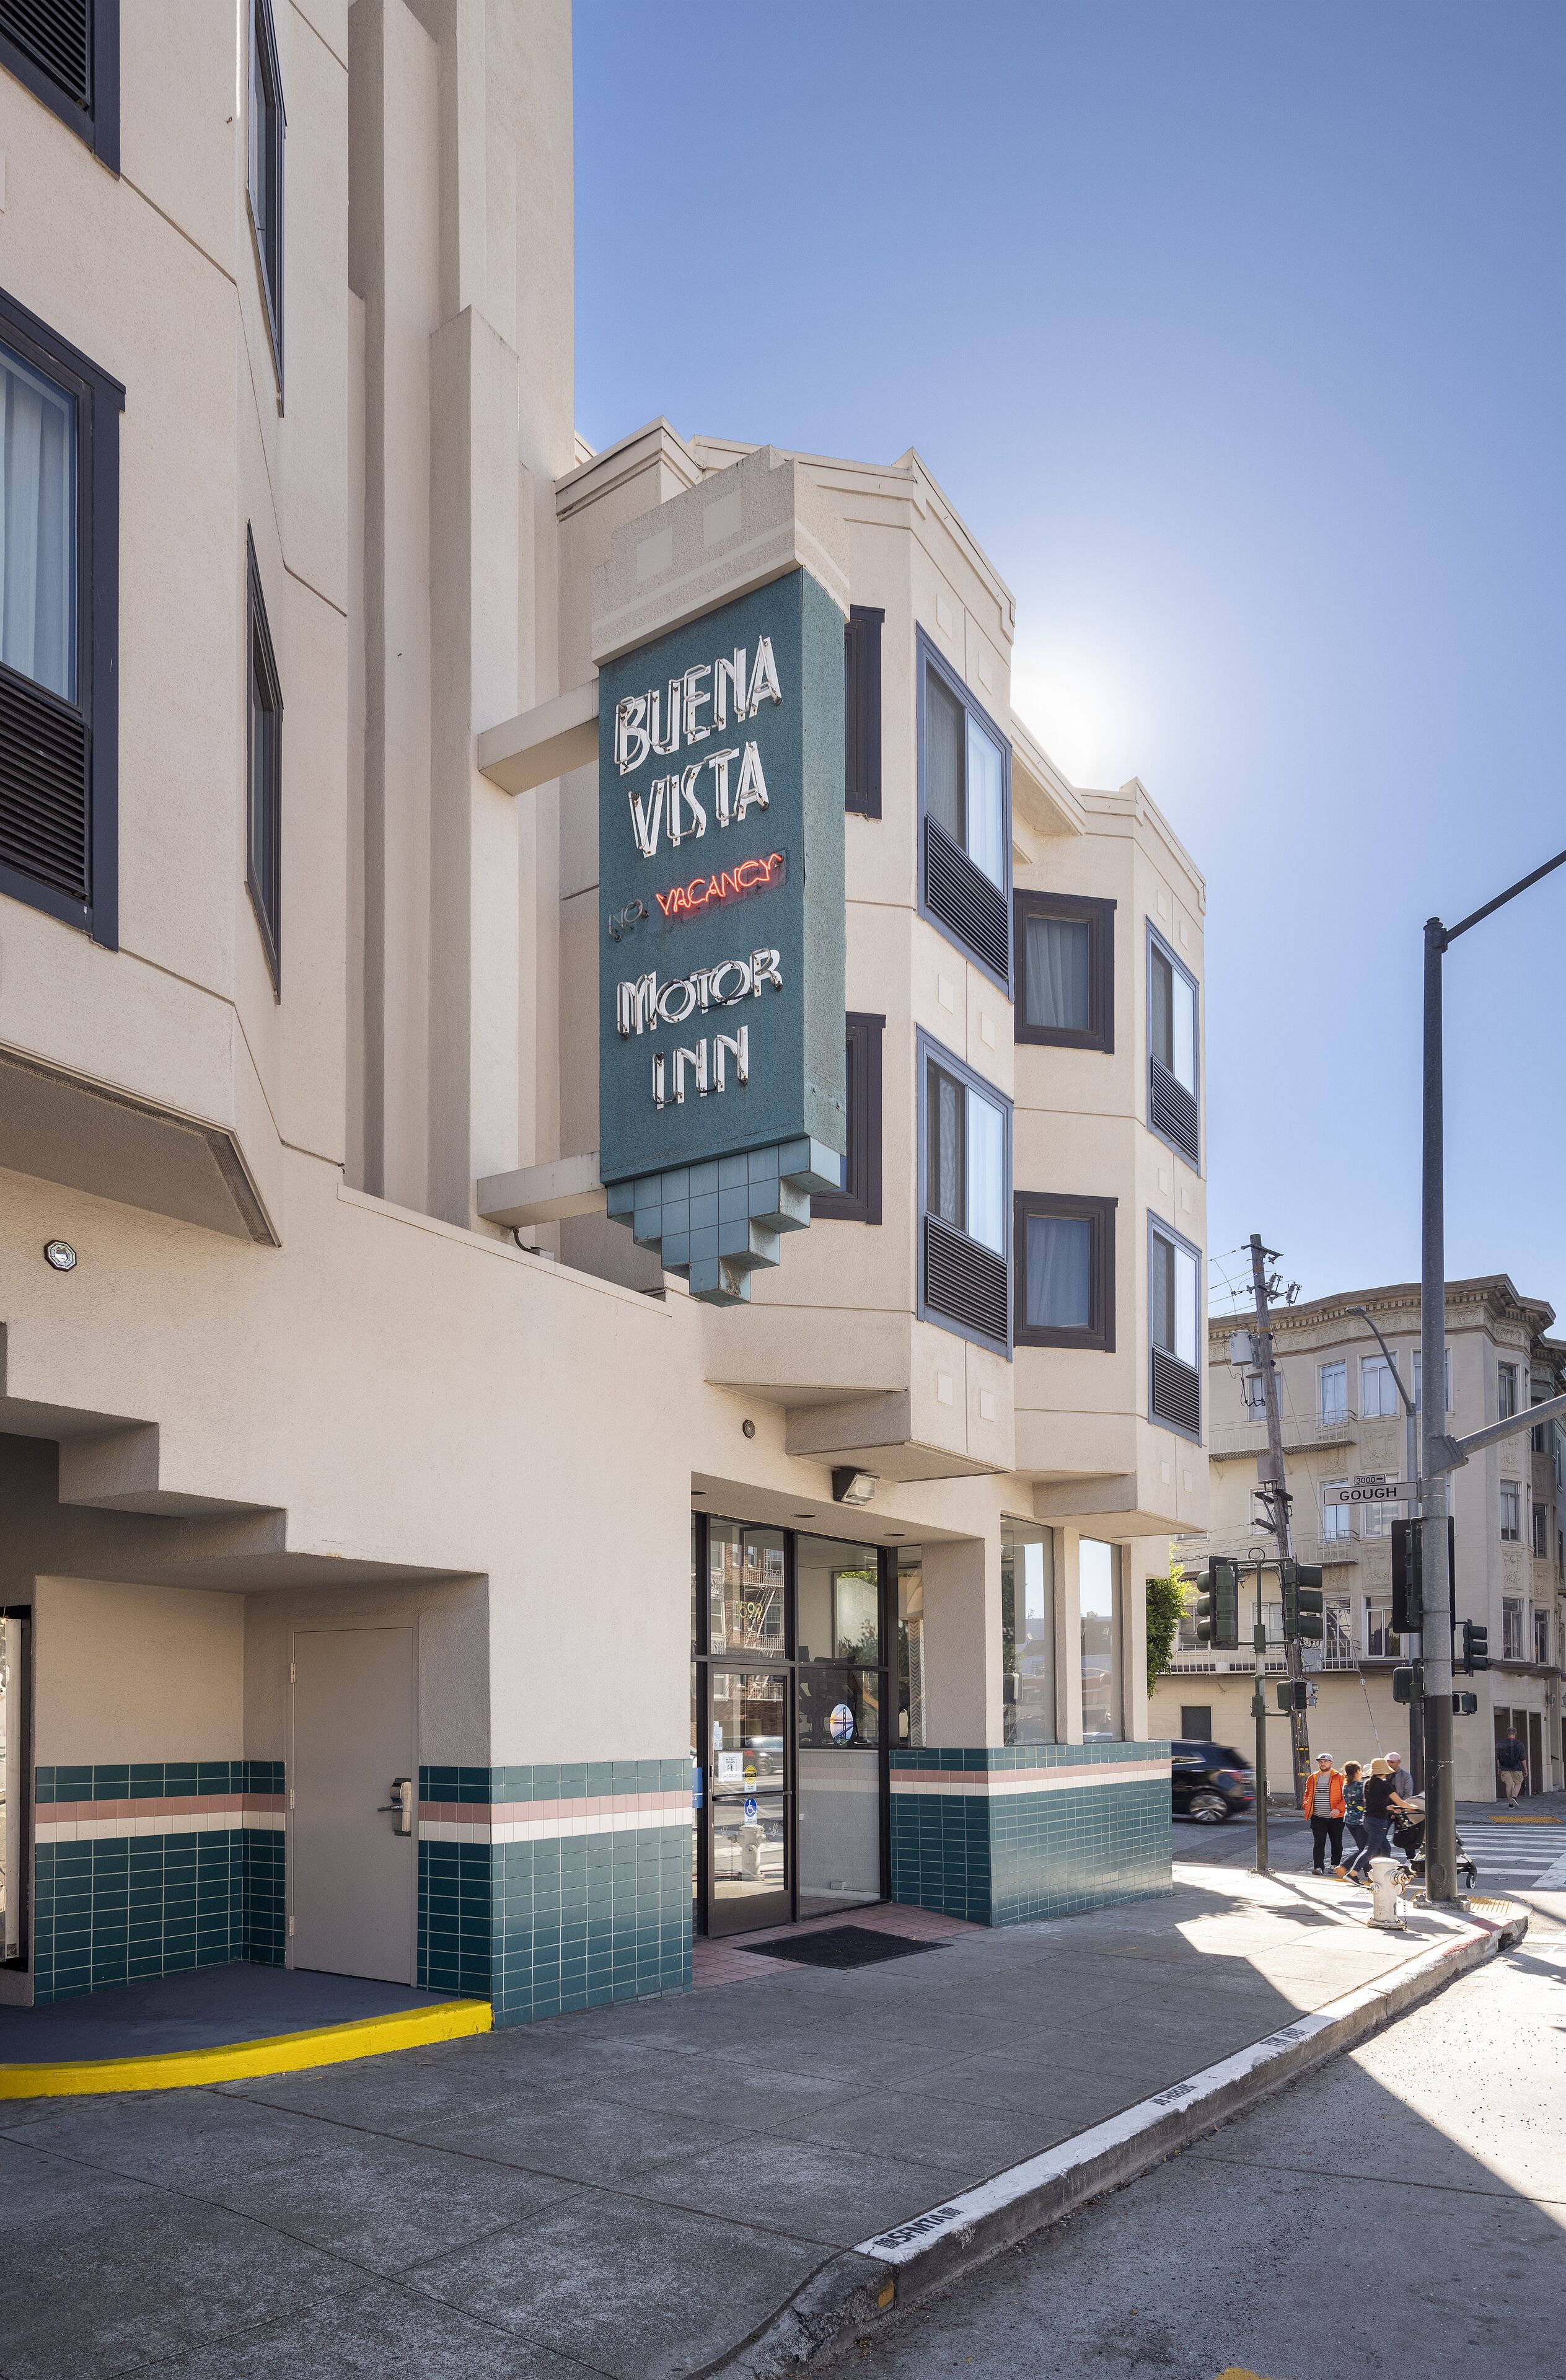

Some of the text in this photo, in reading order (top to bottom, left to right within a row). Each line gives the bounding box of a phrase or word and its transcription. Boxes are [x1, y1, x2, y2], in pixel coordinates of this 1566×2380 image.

[615, 635, 781, 775] BUENA
[628, 741, 768, 858] VISTA
[609, 853, 783, 938] NO VACANCY
[617, 948, 782, 1038] MOTOR
[653, 1025, 749, 1109] INN
[1339, 1487, 1397, 1501] GOUGH
[1356, 1476, 1376, 1484] 3000
[735, 1600, 762, 1620] 1599
[1149, 2084, 1198, 2106] NO PARKING
[887, 2215, 953, 2242] SFMTA
